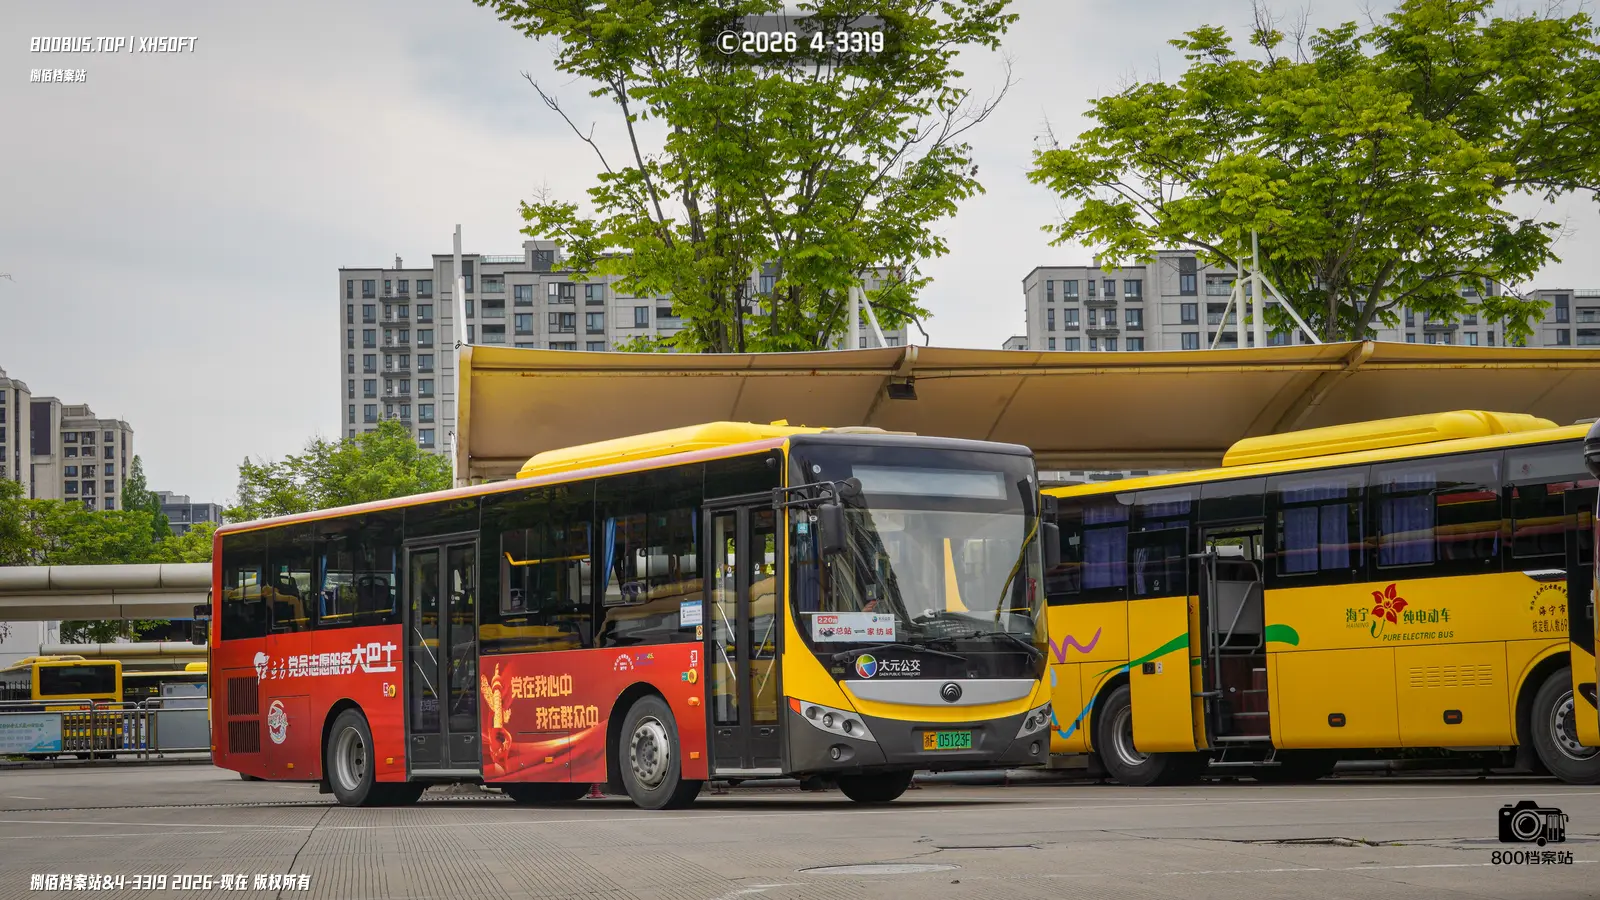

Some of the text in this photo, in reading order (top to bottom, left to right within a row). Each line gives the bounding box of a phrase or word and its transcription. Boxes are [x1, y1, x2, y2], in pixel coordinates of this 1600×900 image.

[1346, 607, 1451, 625] 海宁 纯电动车
[1382, 630, 1454, 642] PURE ELECTRIC BUS
[878, 659, 921, 672] 大元公交
[510, 673, 573, 699] 党在我心中
[535, 704, 599, 730] 我在群众中
